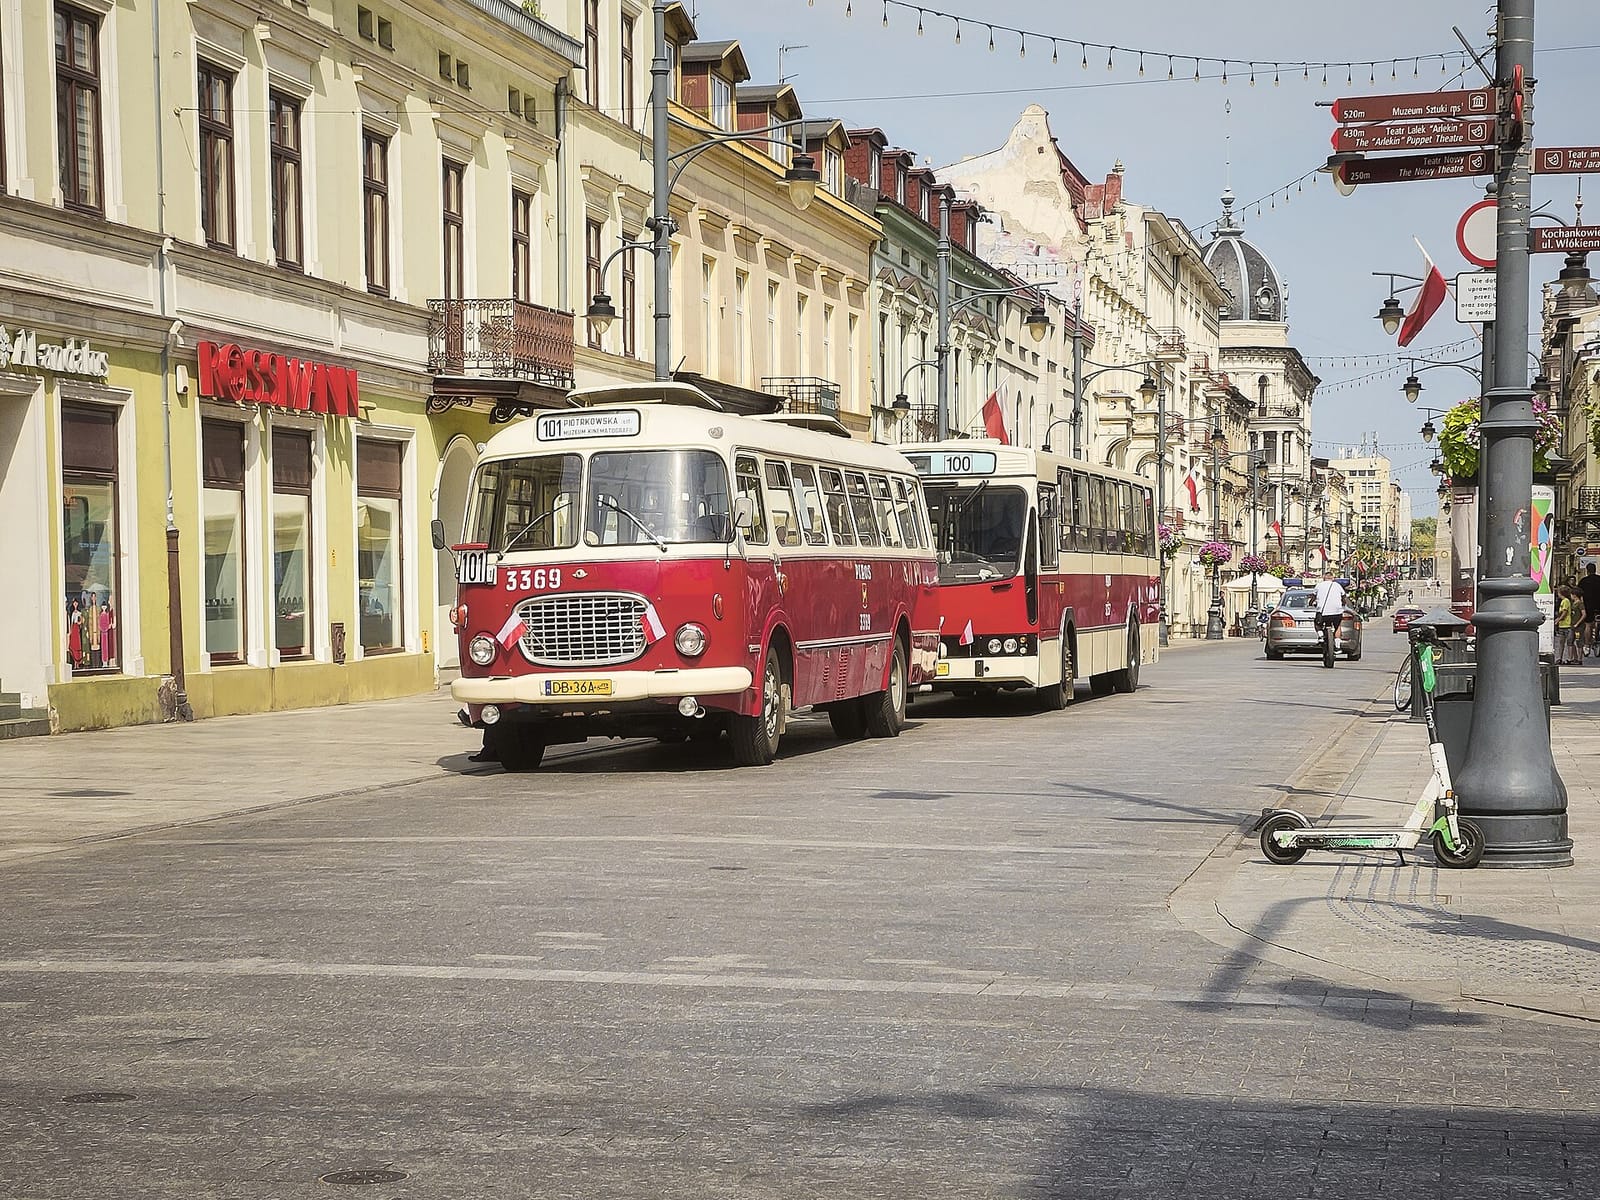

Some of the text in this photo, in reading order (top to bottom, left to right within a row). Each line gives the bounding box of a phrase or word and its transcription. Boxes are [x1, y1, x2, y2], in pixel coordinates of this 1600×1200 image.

[1343, 109, 1365, 119] 520m
[1392, 107, 1423, 116] Muzeum
[1425, 104, 1448, 114] Sztuki
[1343, 128, 1365, 138] 430m
[1385, 126, 1404, 136] Teatr
[1407, 124, 1426, 135] Lalek
[1355, 138, 1369, 147] The
[1406, 134, 1433, 146] Puppet
[1435, 133, 1464, 143] Theatre
[1424, 154, 1465, 166] Teatr Nowy
[1568, 150, 1587, 159] Teatr
[1568, 160, 1582, 168] The
[1350, 170, 1371, 181] 250m
[1399, 164, 1465, 178] The Nowy Theatre
[1541, 238, 1554, 249] ul.
[196, 340, 359, 417] ROSSMANN
[542, 419, 562, 438] 101
[563, 417, 618, 427] PIOTRKOWSKA
[563, 428, 586, 437] MUZEUM
[946, 455, 971, 472] 100
[462, 552, 484, 582] 101
[505, 567, 562, 591] 3369
[552, 681, 595, 694] DB 36A
